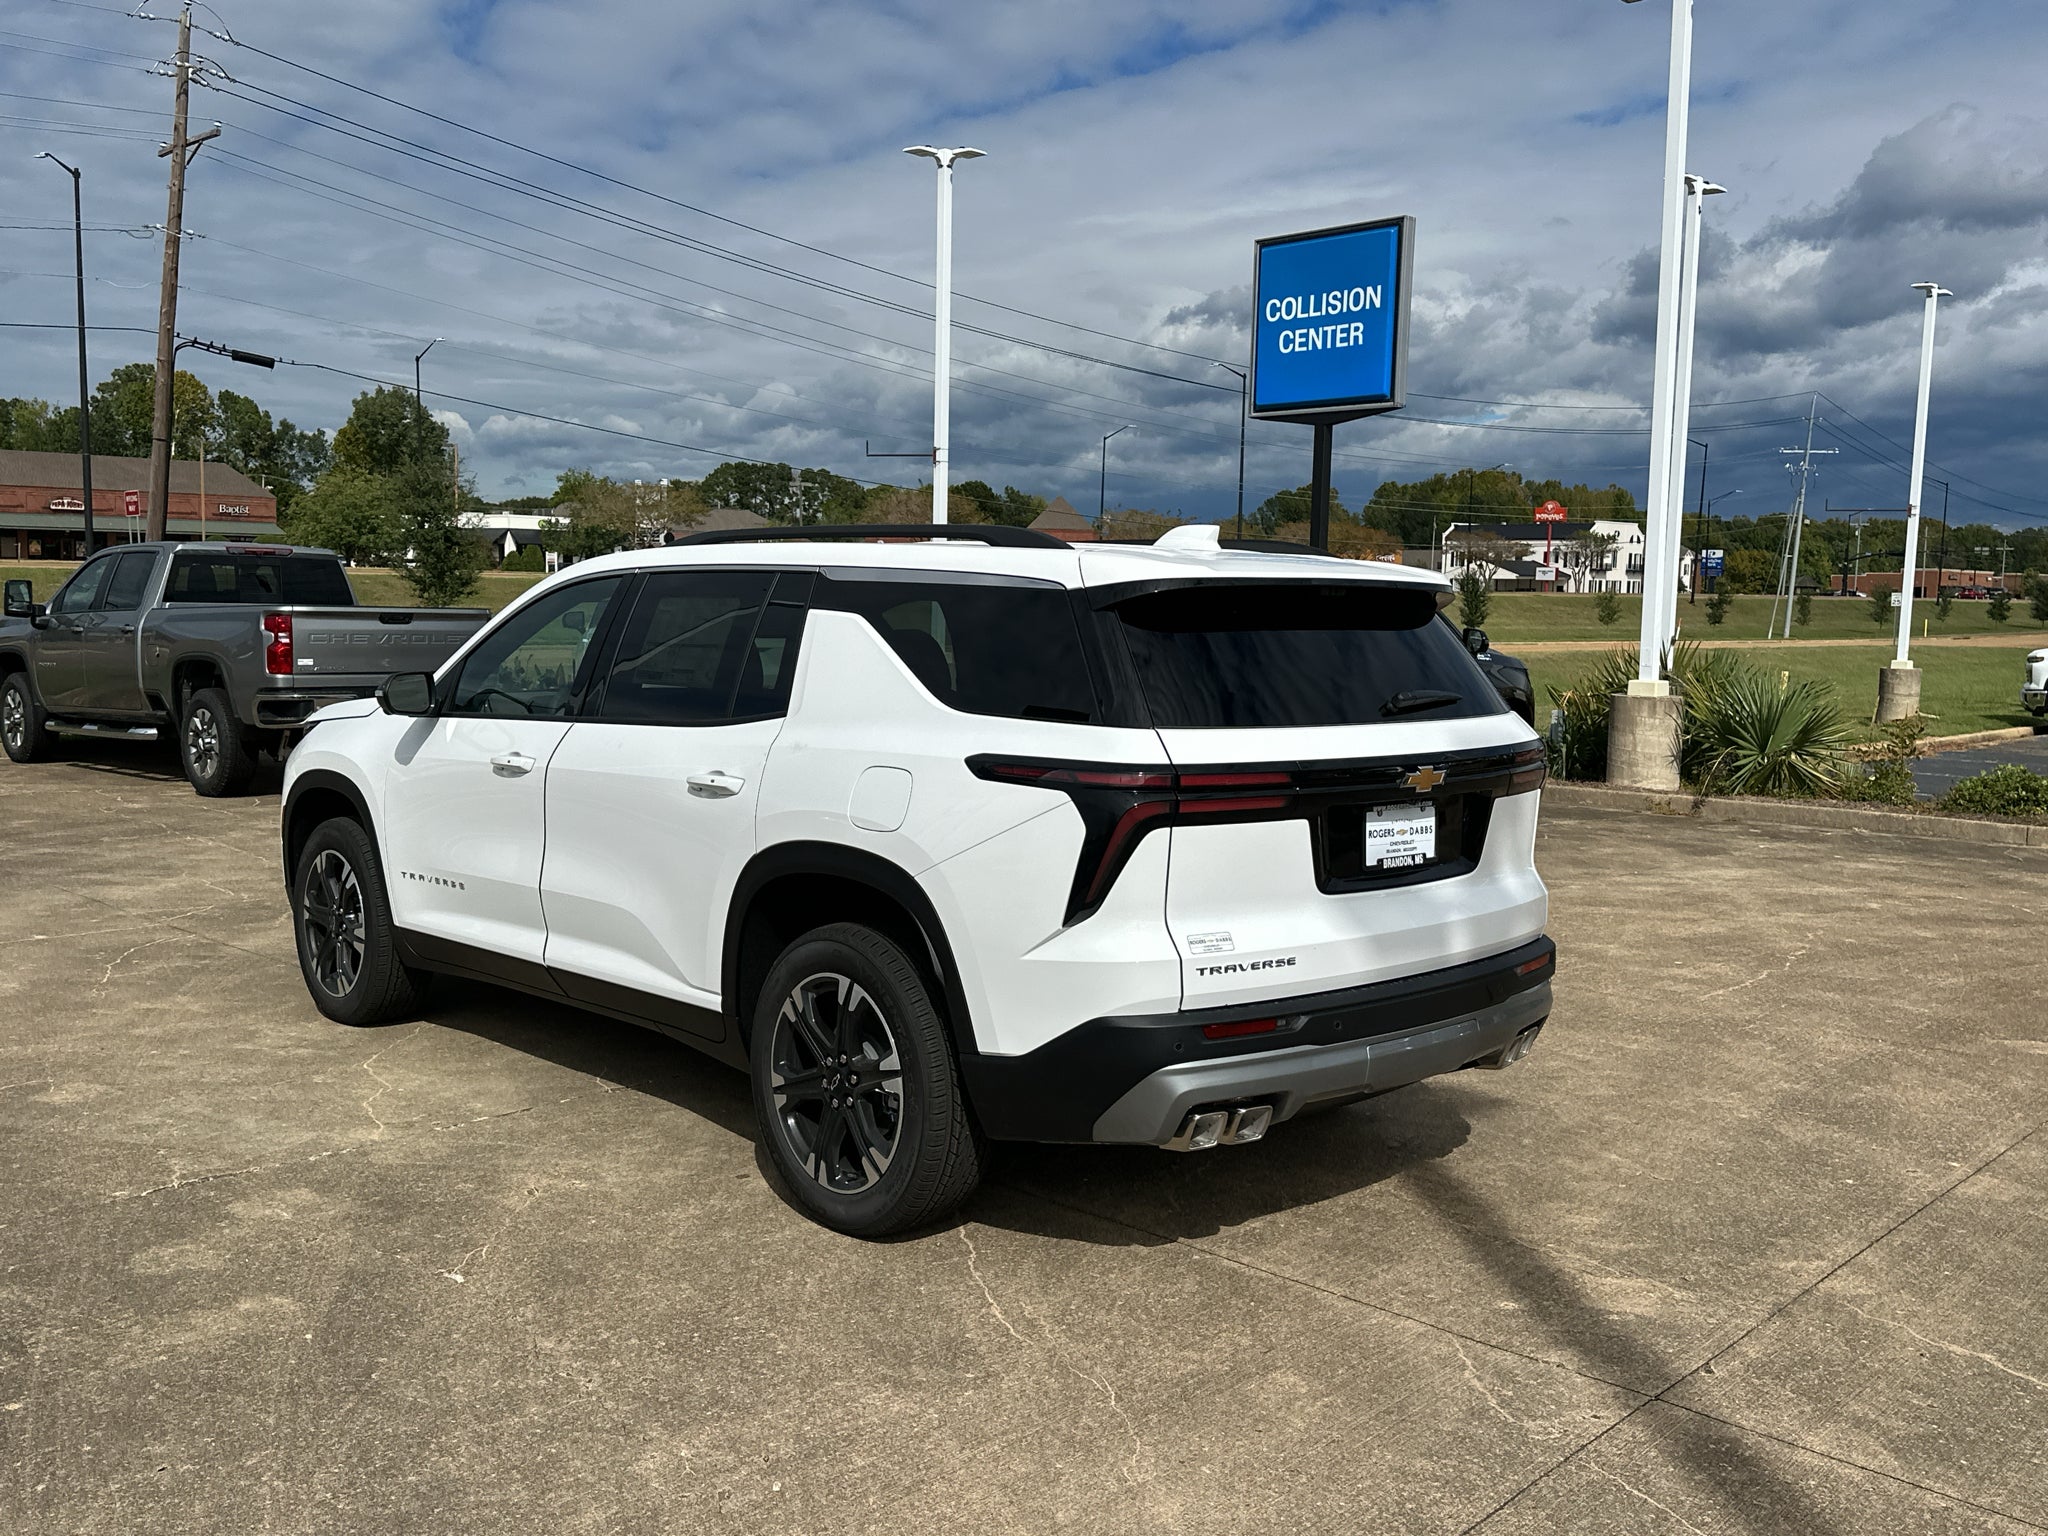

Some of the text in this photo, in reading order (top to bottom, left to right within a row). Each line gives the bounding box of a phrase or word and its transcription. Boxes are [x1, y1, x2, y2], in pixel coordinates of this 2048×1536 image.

[1265, 285, 1382, 322] COLLISION
[1279, 322, 1364, 354] CENTER
[219, 504, 250, 514] Baptist
[309, 634, 468, 645] CHEVROLE
[1368, 825, 1433, 839] ROGERS DABBS
[1383, 854, 1424, 869] BRANDON, MS
[401, 871, 466, 891] TRAVERSE
[1196, 957, 1297, 977] TRAVERSE
